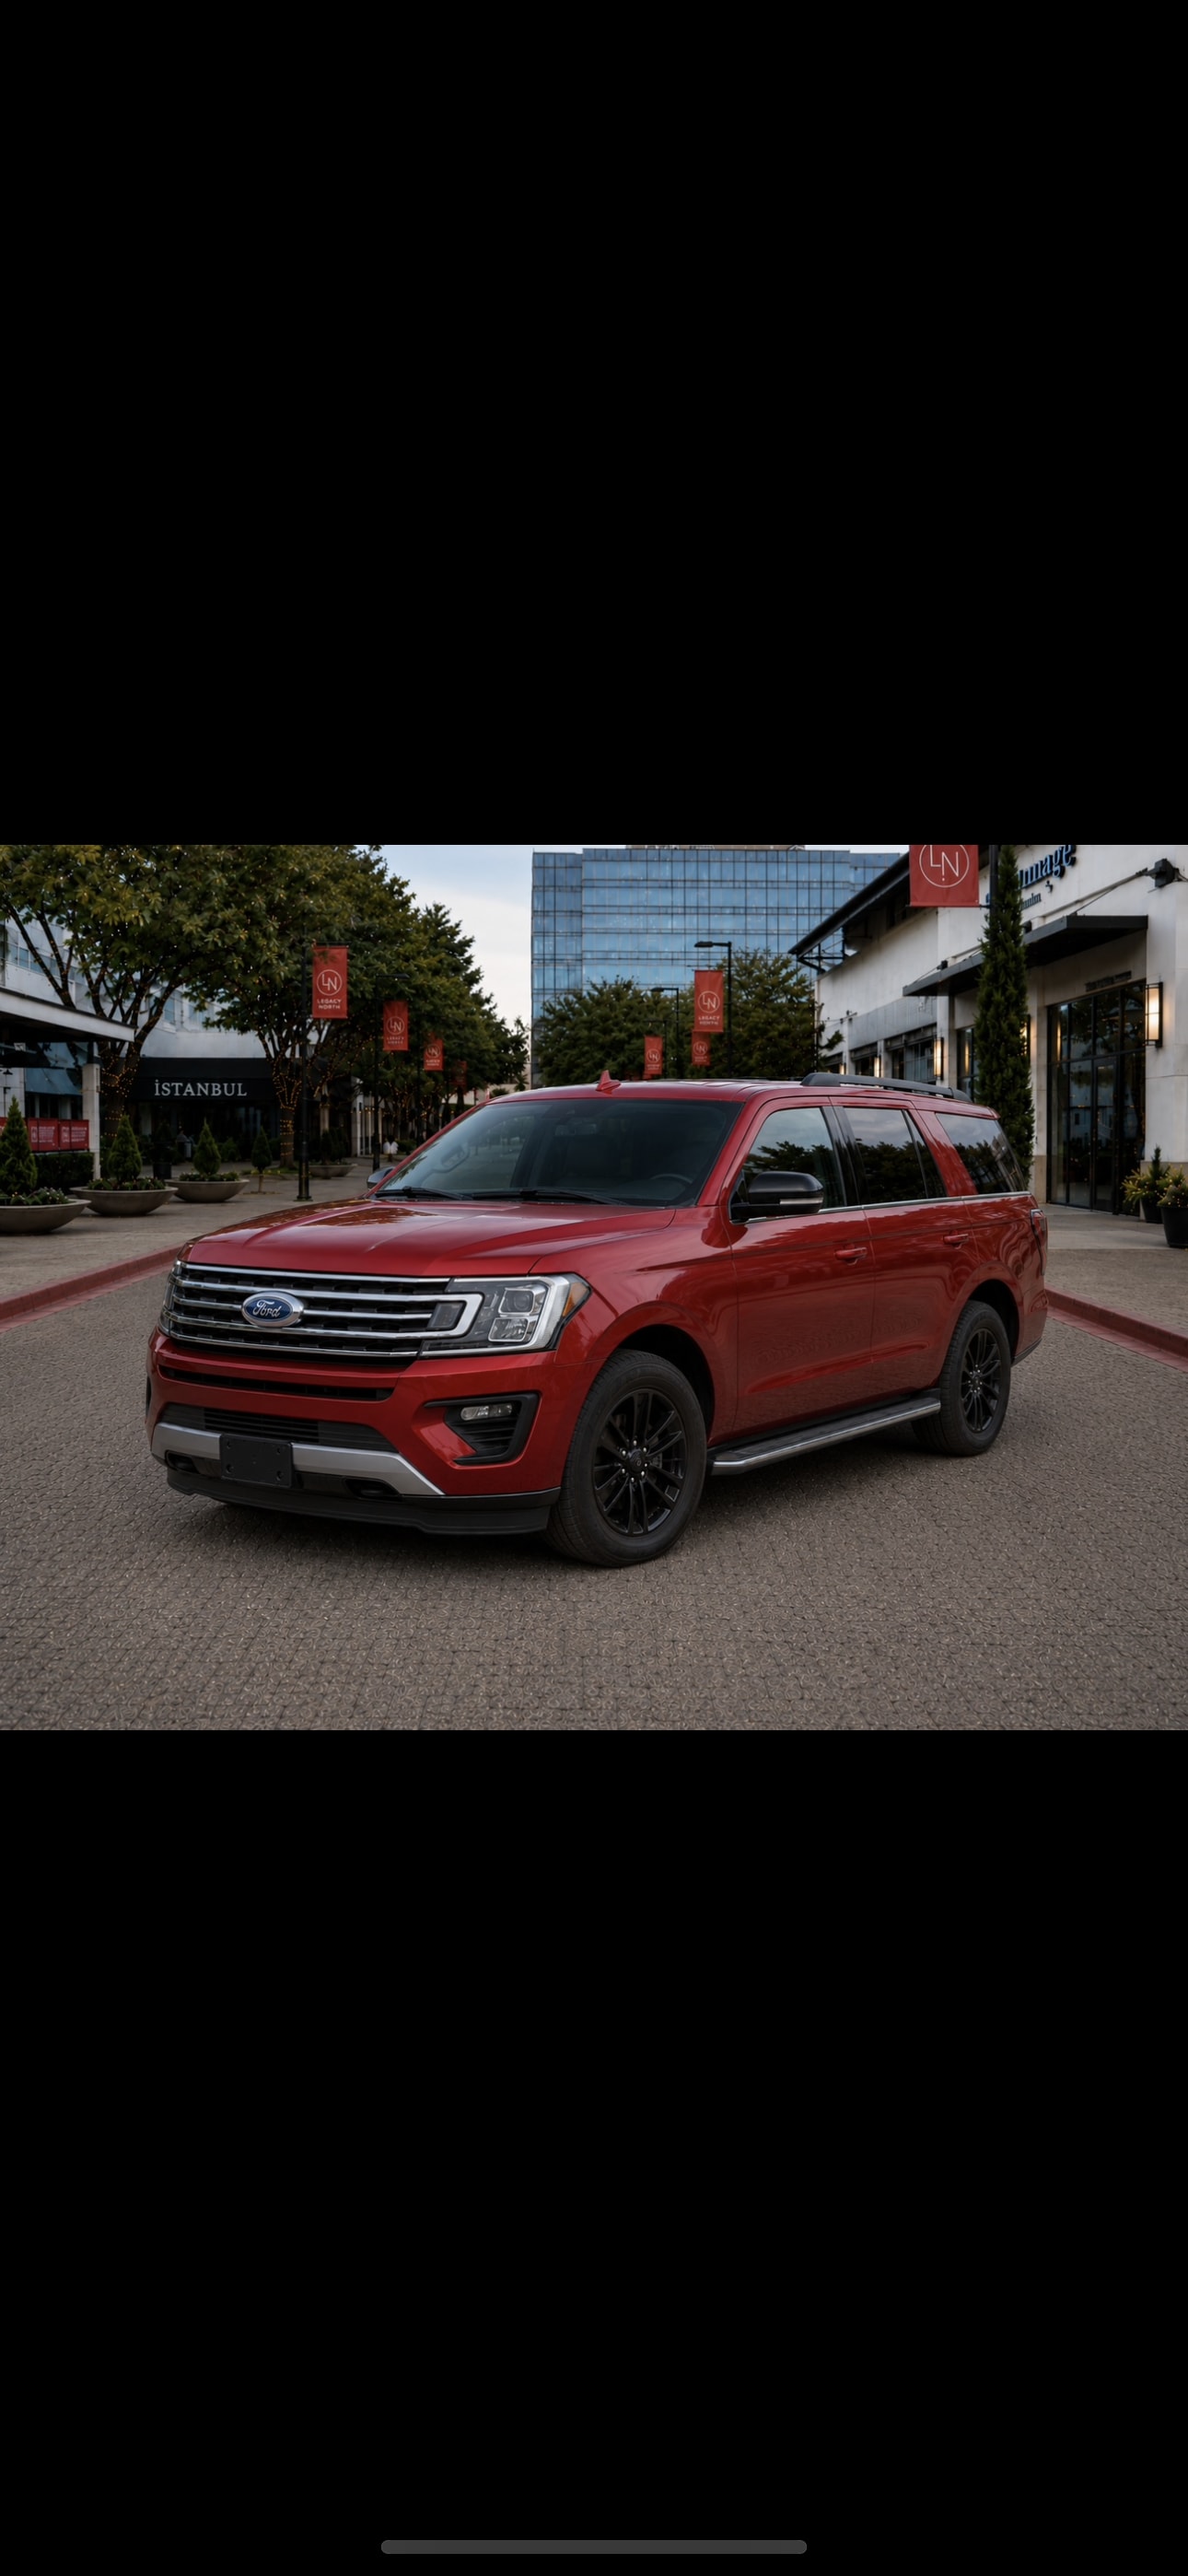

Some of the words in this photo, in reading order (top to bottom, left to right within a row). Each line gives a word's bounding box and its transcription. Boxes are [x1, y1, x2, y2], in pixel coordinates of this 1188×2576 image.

[929, 845, 960, 877] LN
[321, 973, 338, 991] LN
[702, 994, 717, 1011] LN
[154, 1079, 248, 1097] İSTANBUL
[252, 1299, 282, 1317] Ford
